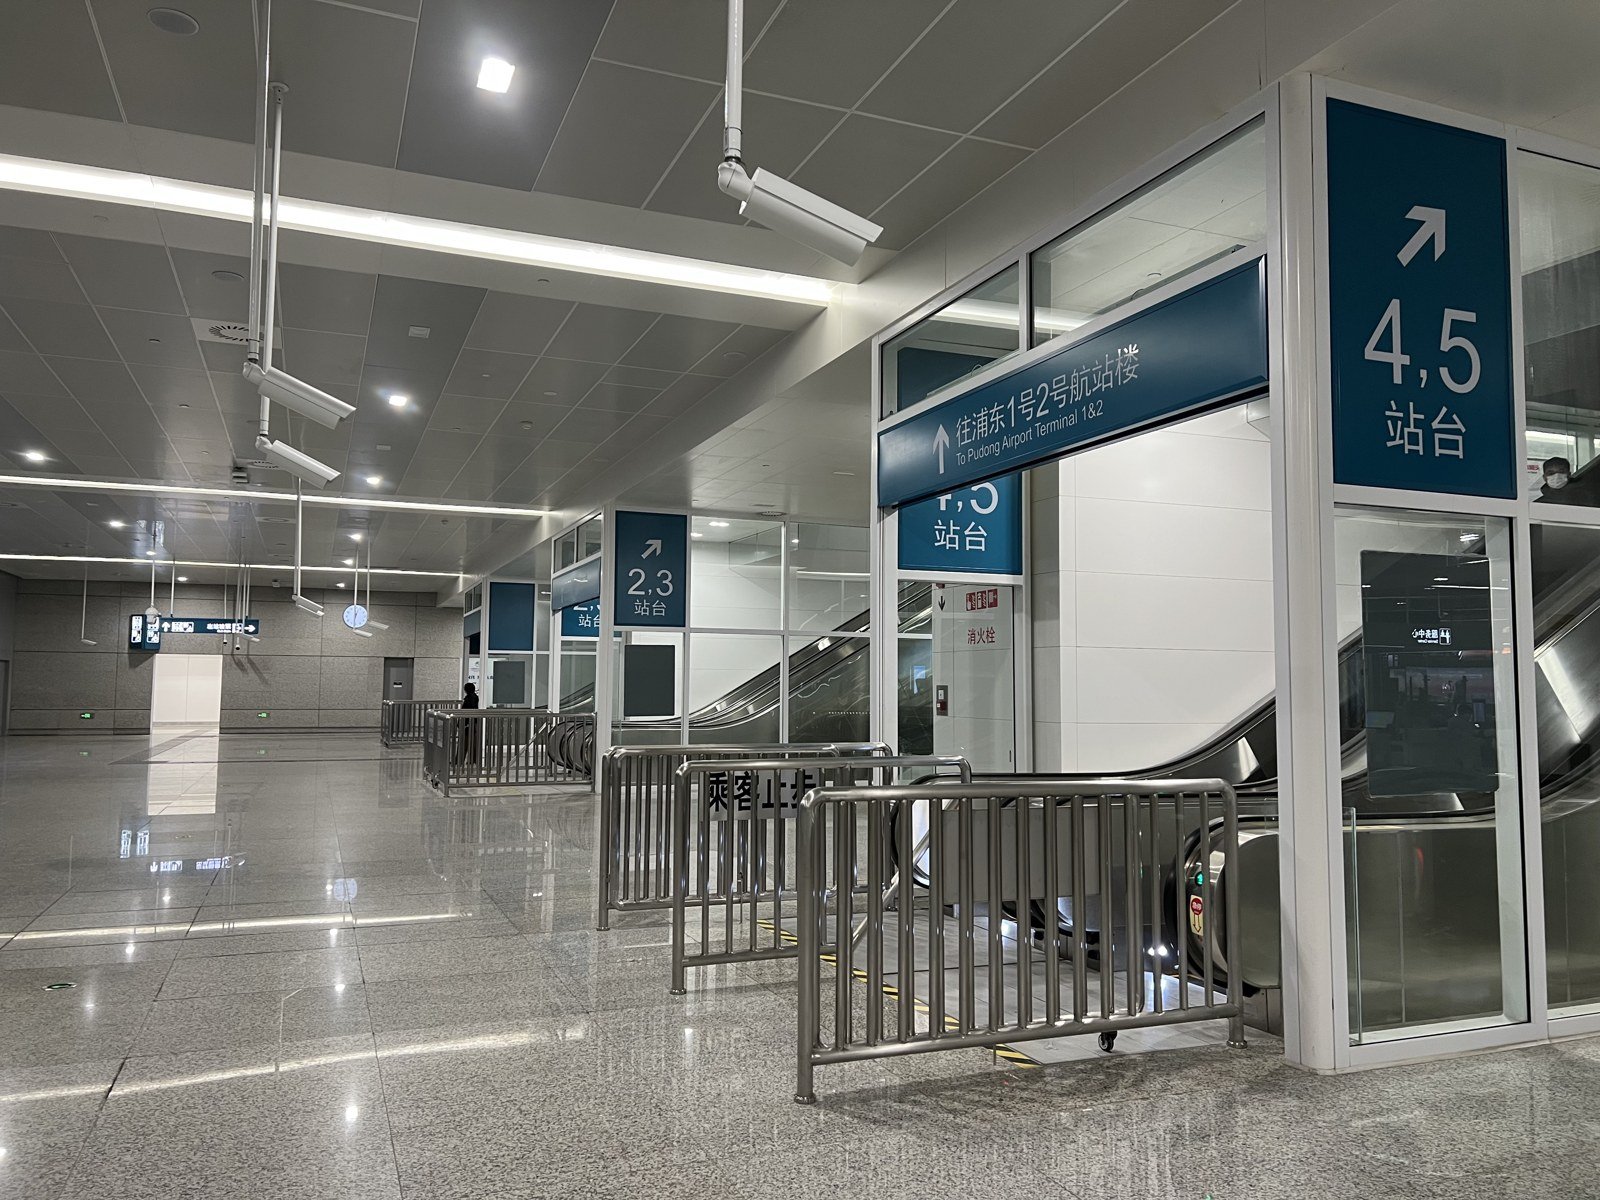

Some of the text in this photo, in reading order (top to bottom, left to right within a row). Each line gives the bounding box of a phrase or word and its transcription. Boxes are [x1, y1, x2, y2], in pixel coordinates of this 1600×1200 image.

[1364, 298, 1482, 395] 4,5
[956, 343, 1140, 448] 往浦东1号2号航站楼
[956, 399, 1104, 466] To Pudong Airport Terminal 1&2
[1385, 400, 1467, 460] 站台
[934, 519, 988, 552] 站台
[628, 568, 674, 597] 2,3
[634, 599, 667, 617] 站台
[967, 626, 996, 645] 消火栓
